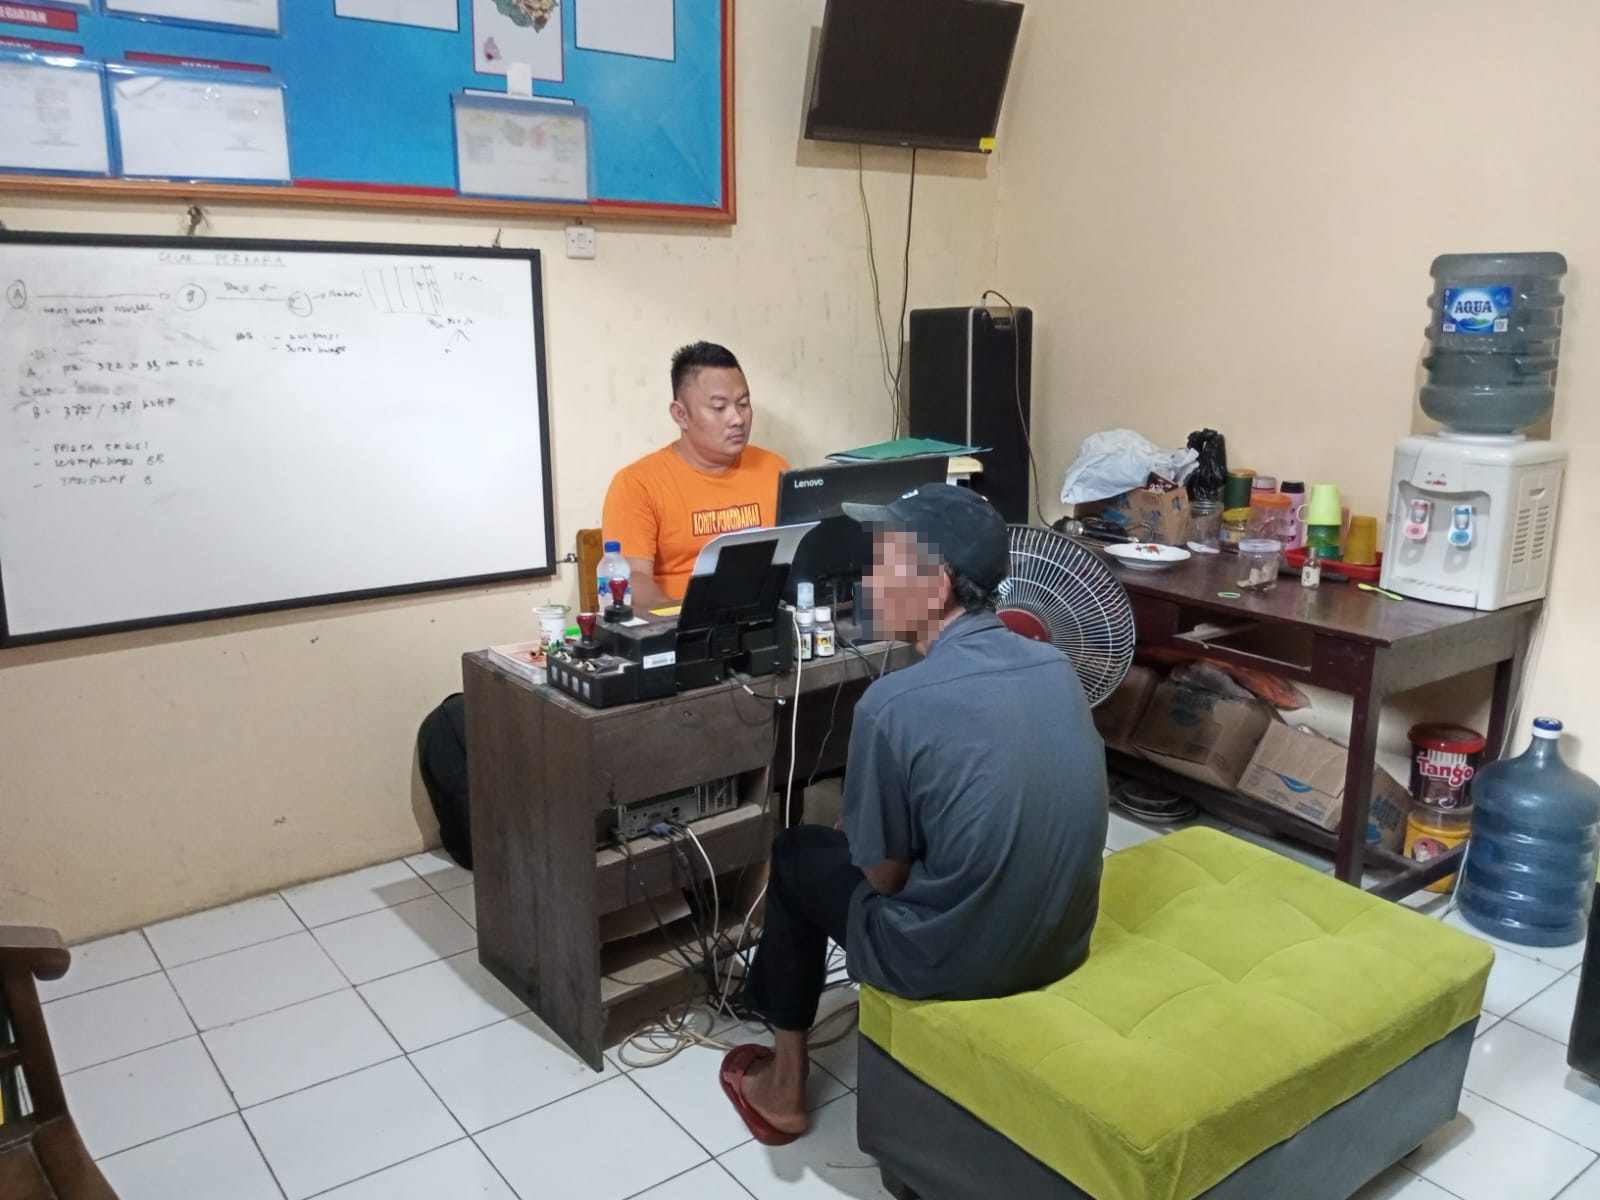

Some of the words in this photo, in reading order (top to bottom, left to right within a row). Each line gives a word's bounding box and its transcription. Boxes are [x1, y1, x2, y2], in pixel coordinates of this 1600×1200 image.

[1454, 300, 1493, 316] AQUA
[794, 478, 824, 489] Lenovo
[1417, 757, 1474, 787] Tango
